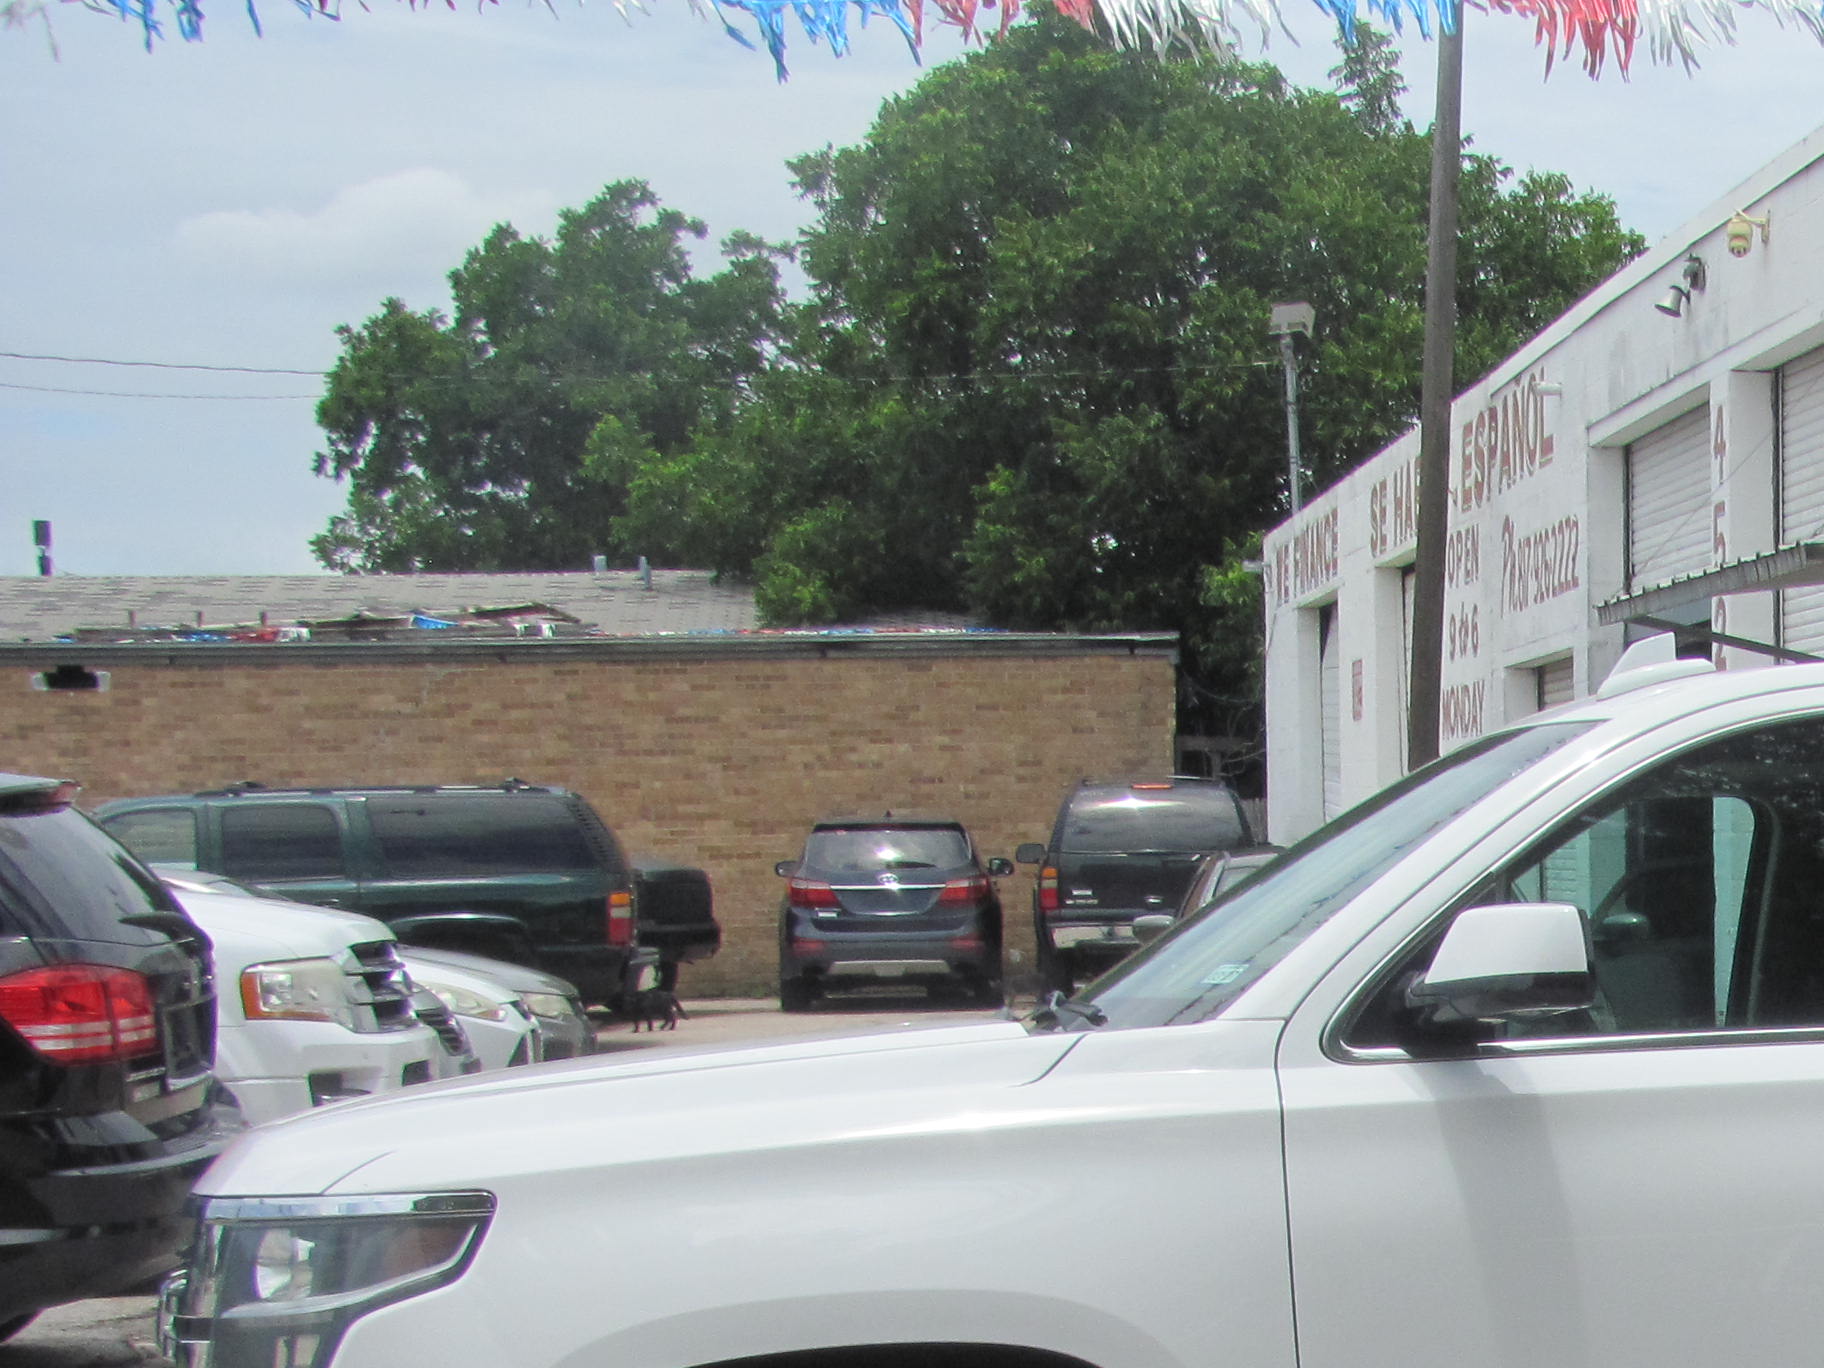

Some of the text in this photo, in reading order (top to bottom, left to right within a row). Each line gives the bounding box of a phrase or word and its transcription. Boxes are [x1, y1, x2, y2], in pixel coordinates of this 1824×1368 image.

[1370, 477, 1387, 559] SE
[1461, 365, 1554, 513] ESPAÑOL
[1293, 507, 1338, 599] FINANCE
[1445, 522, 1479, 588] OPEN
[1449, 602, 1479, 663] 9 to 6
[1443, 679, 1485, 740] MONDAY
